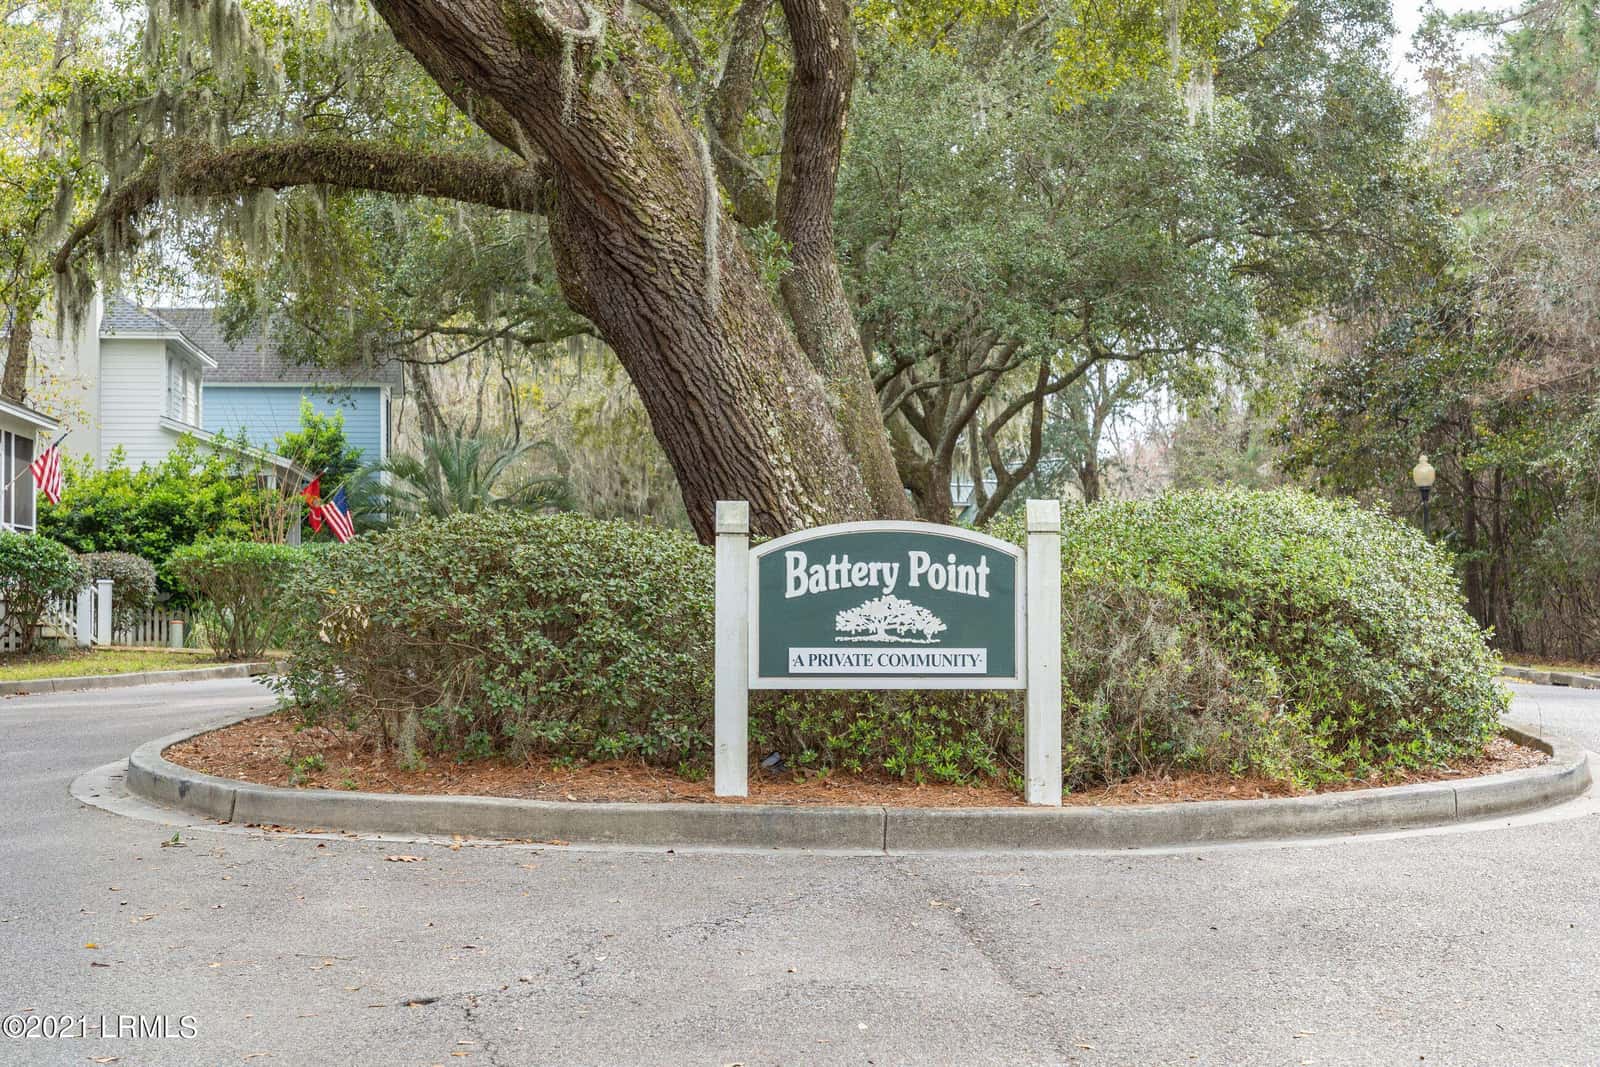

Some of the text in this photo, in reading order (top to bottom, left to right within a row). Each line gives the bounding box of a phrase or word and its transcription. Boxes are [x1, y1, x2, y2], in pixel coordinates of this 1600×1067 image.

[784, 550, 990, 599] Battery Point
[808, 653, 874, 668] PRIVATE
[877, 653, 980, 668] COMMUNITY
